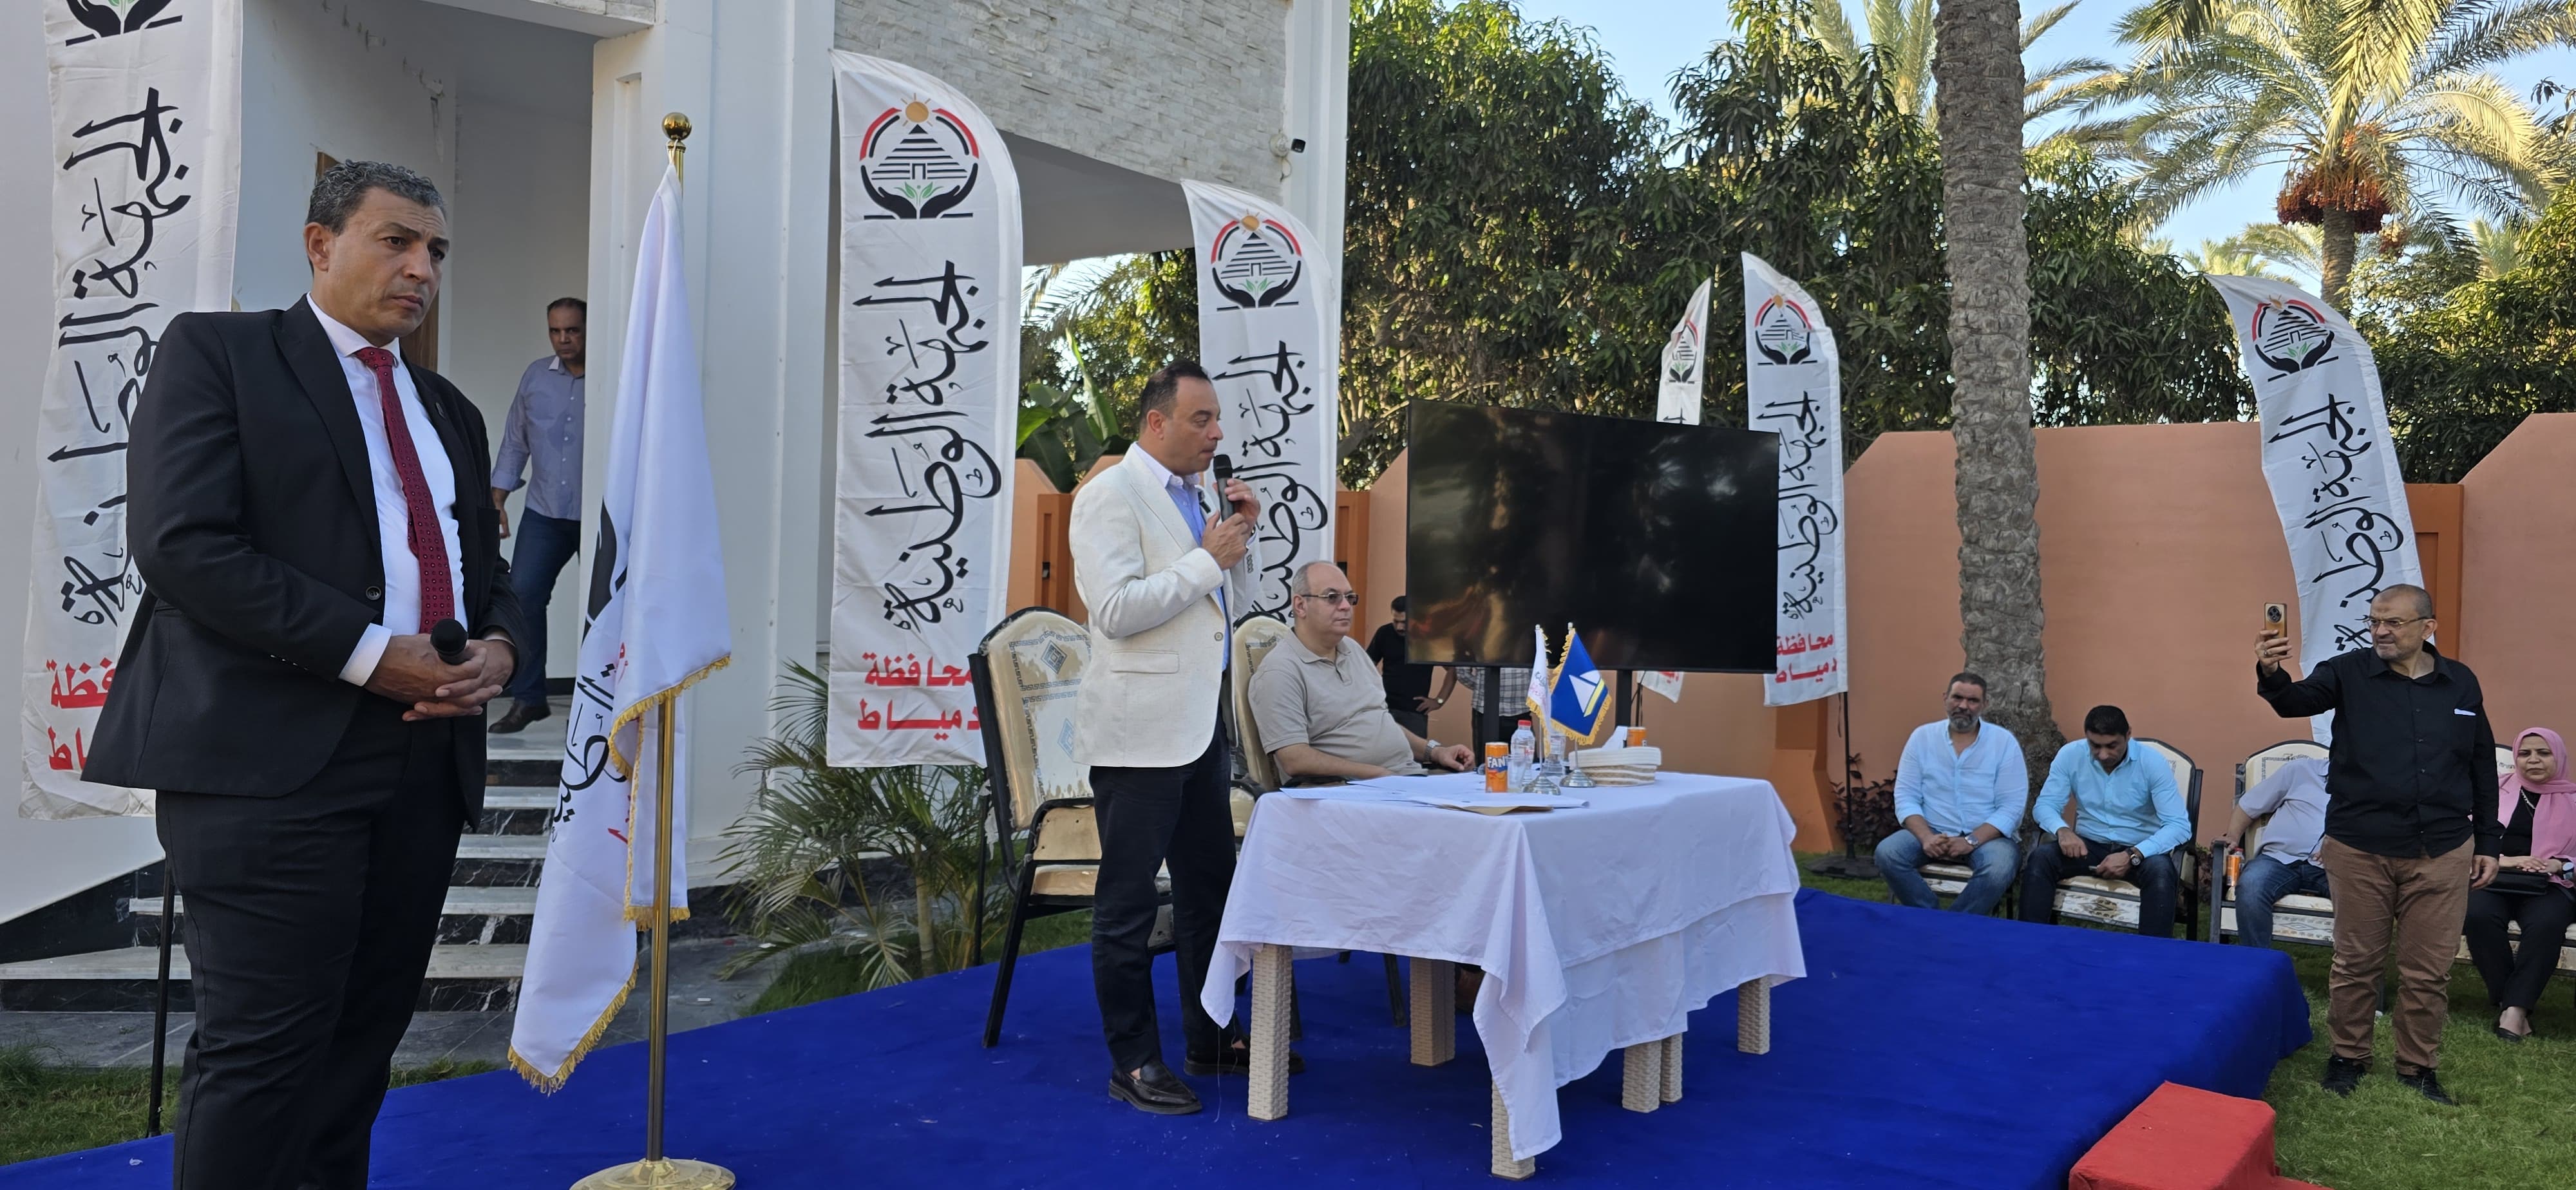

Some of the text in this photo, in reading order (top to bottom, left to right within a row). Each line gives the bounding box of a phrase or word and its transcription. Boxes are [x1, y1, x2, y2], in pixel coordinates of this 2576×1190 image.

[48, 87, 191, 627] الجبهة الوطنة
[1212, 340, 1314, 458] الجبهة
[853, 260, 1001, 634] الجبهة الوطنية
[2268, 393, 2371, 503] الجبهة
[1756, 391, 1838, 619] الجبهة الوطنية
[1777, 633, 1833, 655] محافظة
[858, 698, 981, 740] دمياط
[1487, 755, 1508, 768] FAN
